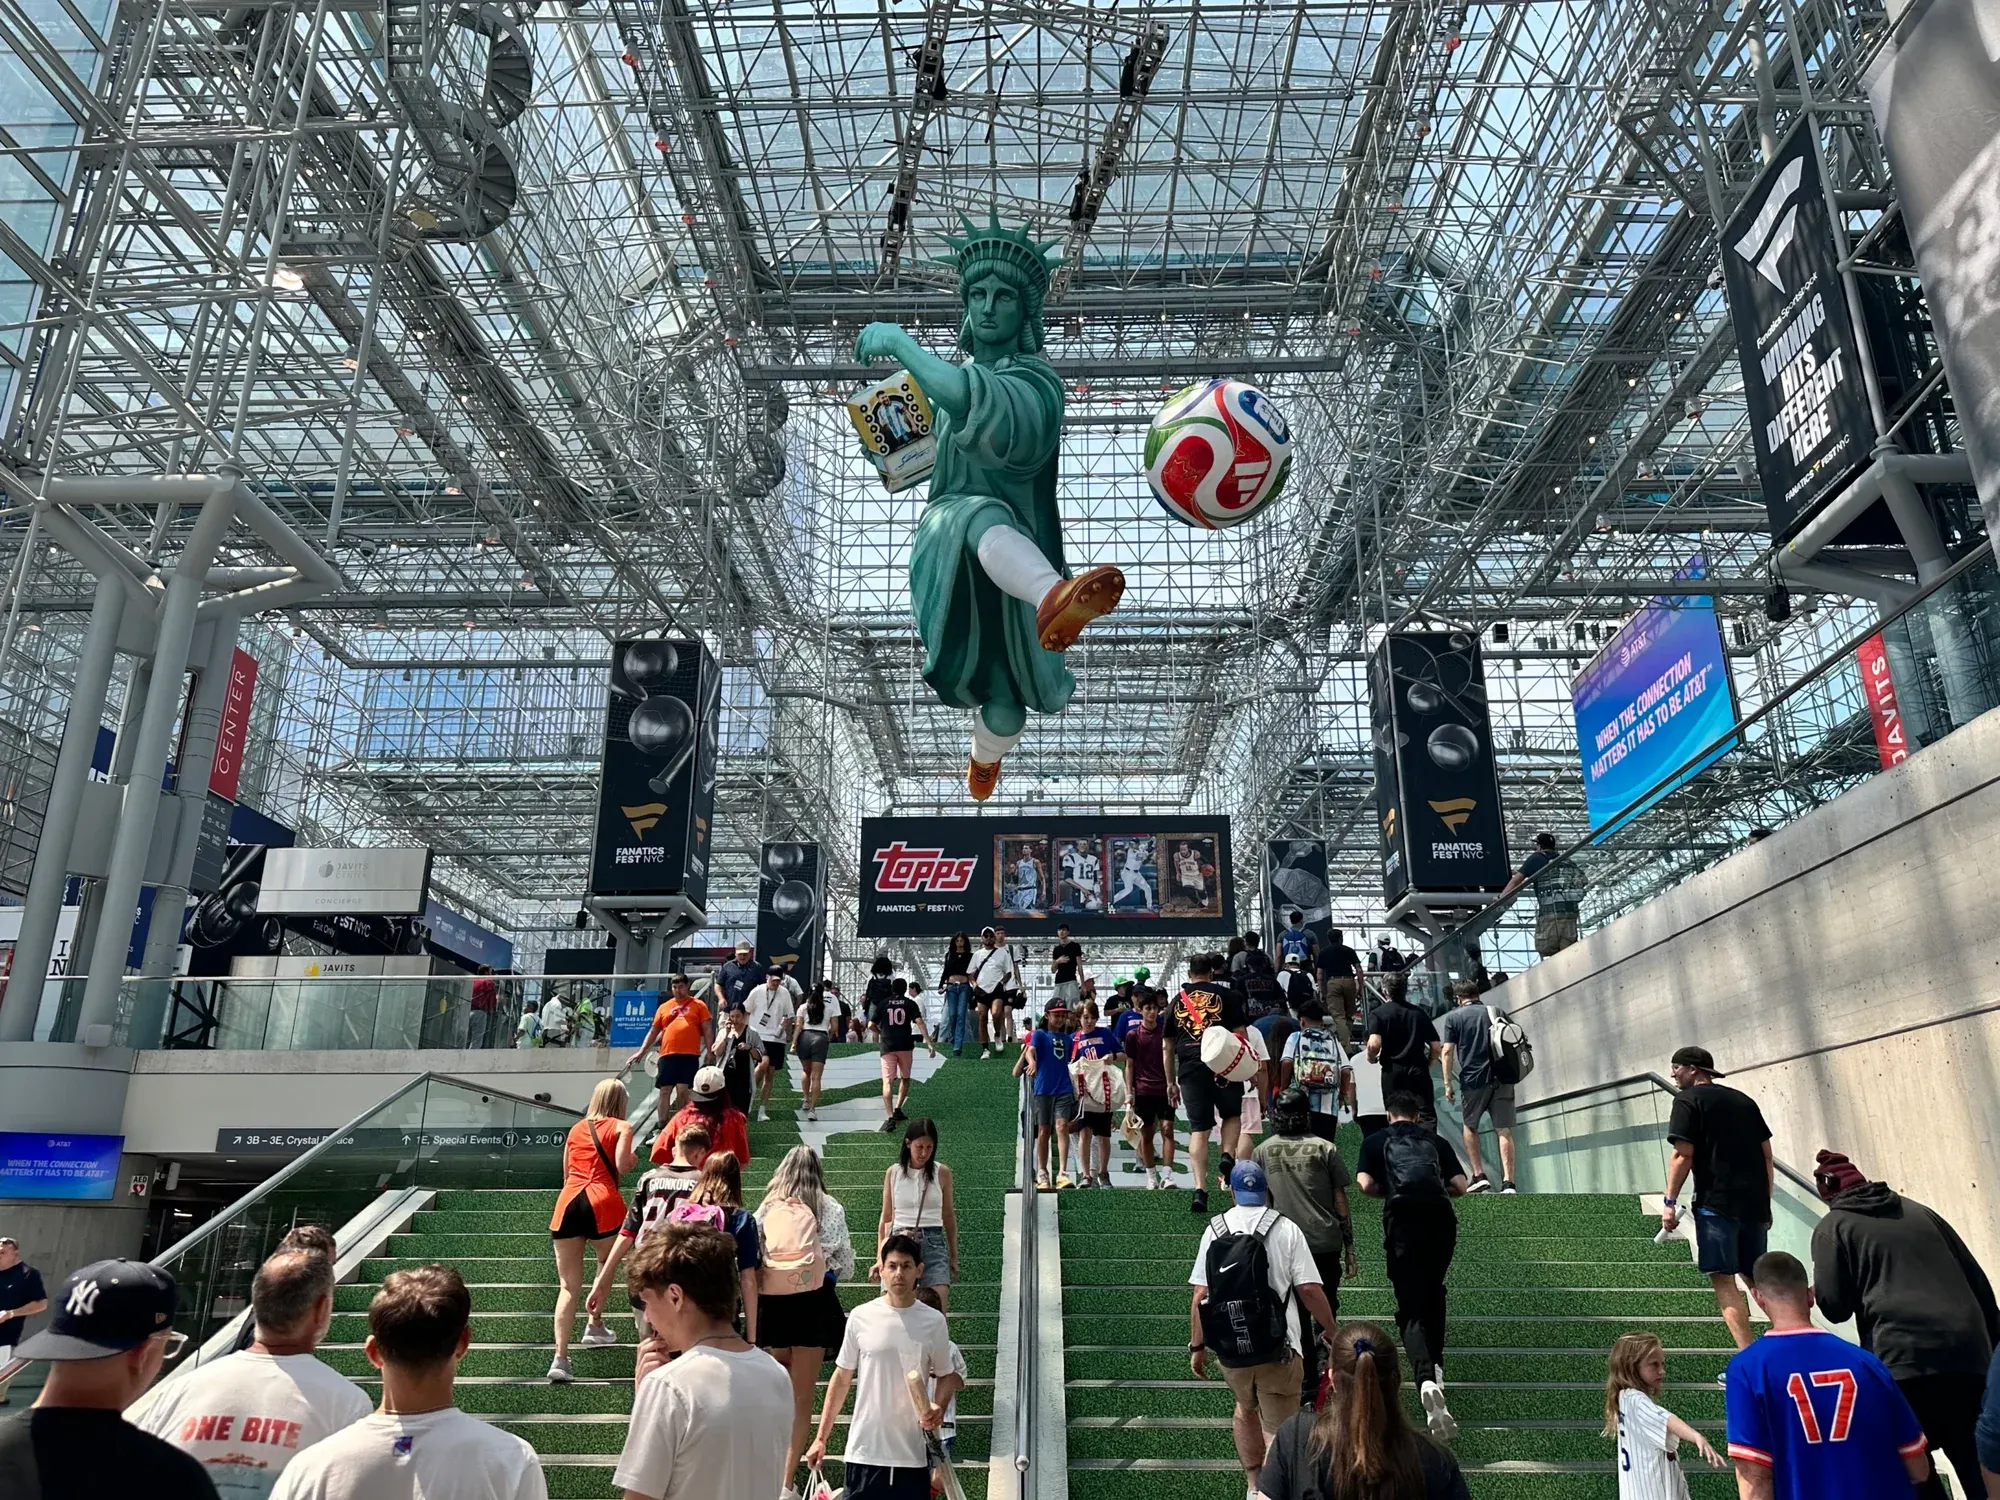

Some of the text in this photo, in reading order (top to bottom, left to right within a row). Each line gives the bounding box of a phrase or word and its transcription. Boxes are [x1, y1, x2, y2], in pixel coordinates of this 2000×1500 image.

[1756, 271, 1818, 350] Fanatics Sportsbook
[1760, 292, 1826, 387] WINNING
[1780, 342, 1816, 402] HITS
[1765, 346, 1844, 454] DIFFERENT
[1789, 401, 1832, 467] HERE
[1784, 468, 1815, 502] FANATICS
[1820, 445, 1837, 468] FEST
[1836, 433, 1850, 453] NYC
[1630, 631, 1647, 656] AT&T
[1594, 651, 1692, 752] WHEN THE CONNECTION
[1871, 655, 1907, 765] JAVITS
[219, 670, 246, 775] CENTER
[1590, 746, 1628, 783] MATTERS
[1627, 730, 1636, 752] IT
[1636, 713, 1656, 744] HAS
[1654, 702, 1669, 728] TO
[1668, 690, 1683, 717] BE
[1683, 667, 1707, 707] AT&T
[615, 846, 665, 856] FANATICS
[1431, 842, 1483, 851] FANATICS
[1433, 850, 1484, 859] FEST NYC
[336, 862, 369, 871] JAVITS
[615, 854, 664, 864] FEST NYC
[876, 904, 965, 912] FANATICS FEST NYC
[354, 919, 371, 938] NYC
[322, 964, 355, 973] JAVITS
[886, 1007, 906, 1026] 10
[246, 1135, 260, 1145] 3B
[269, 1135, 284, 1146] 3E,
[286, 1135, 320, 1147] Crystal
[433, 1135, 468, 1147] Special
[470, 1135, 502, 1145] Events
[535, 1135, 549, 1144] 2D
[1267, 1143, 1318, 1158] OVO
[7, 1158, 99, 1170] WHEN THE CONNECTION
[35, 1168, 44, 1177] IT
[44, 1168, 61, 1178] HAS
[62, 1169, 74, 1178] TO
[74, 1169, 85, 1178] BE
[84, 1169, 105, 1179] AT&T
[133, 1175, 147, 1183] AED
[1786, 1368, 1858, 1444] 17
[179, 1415, 304, 1450] ONE BITE
